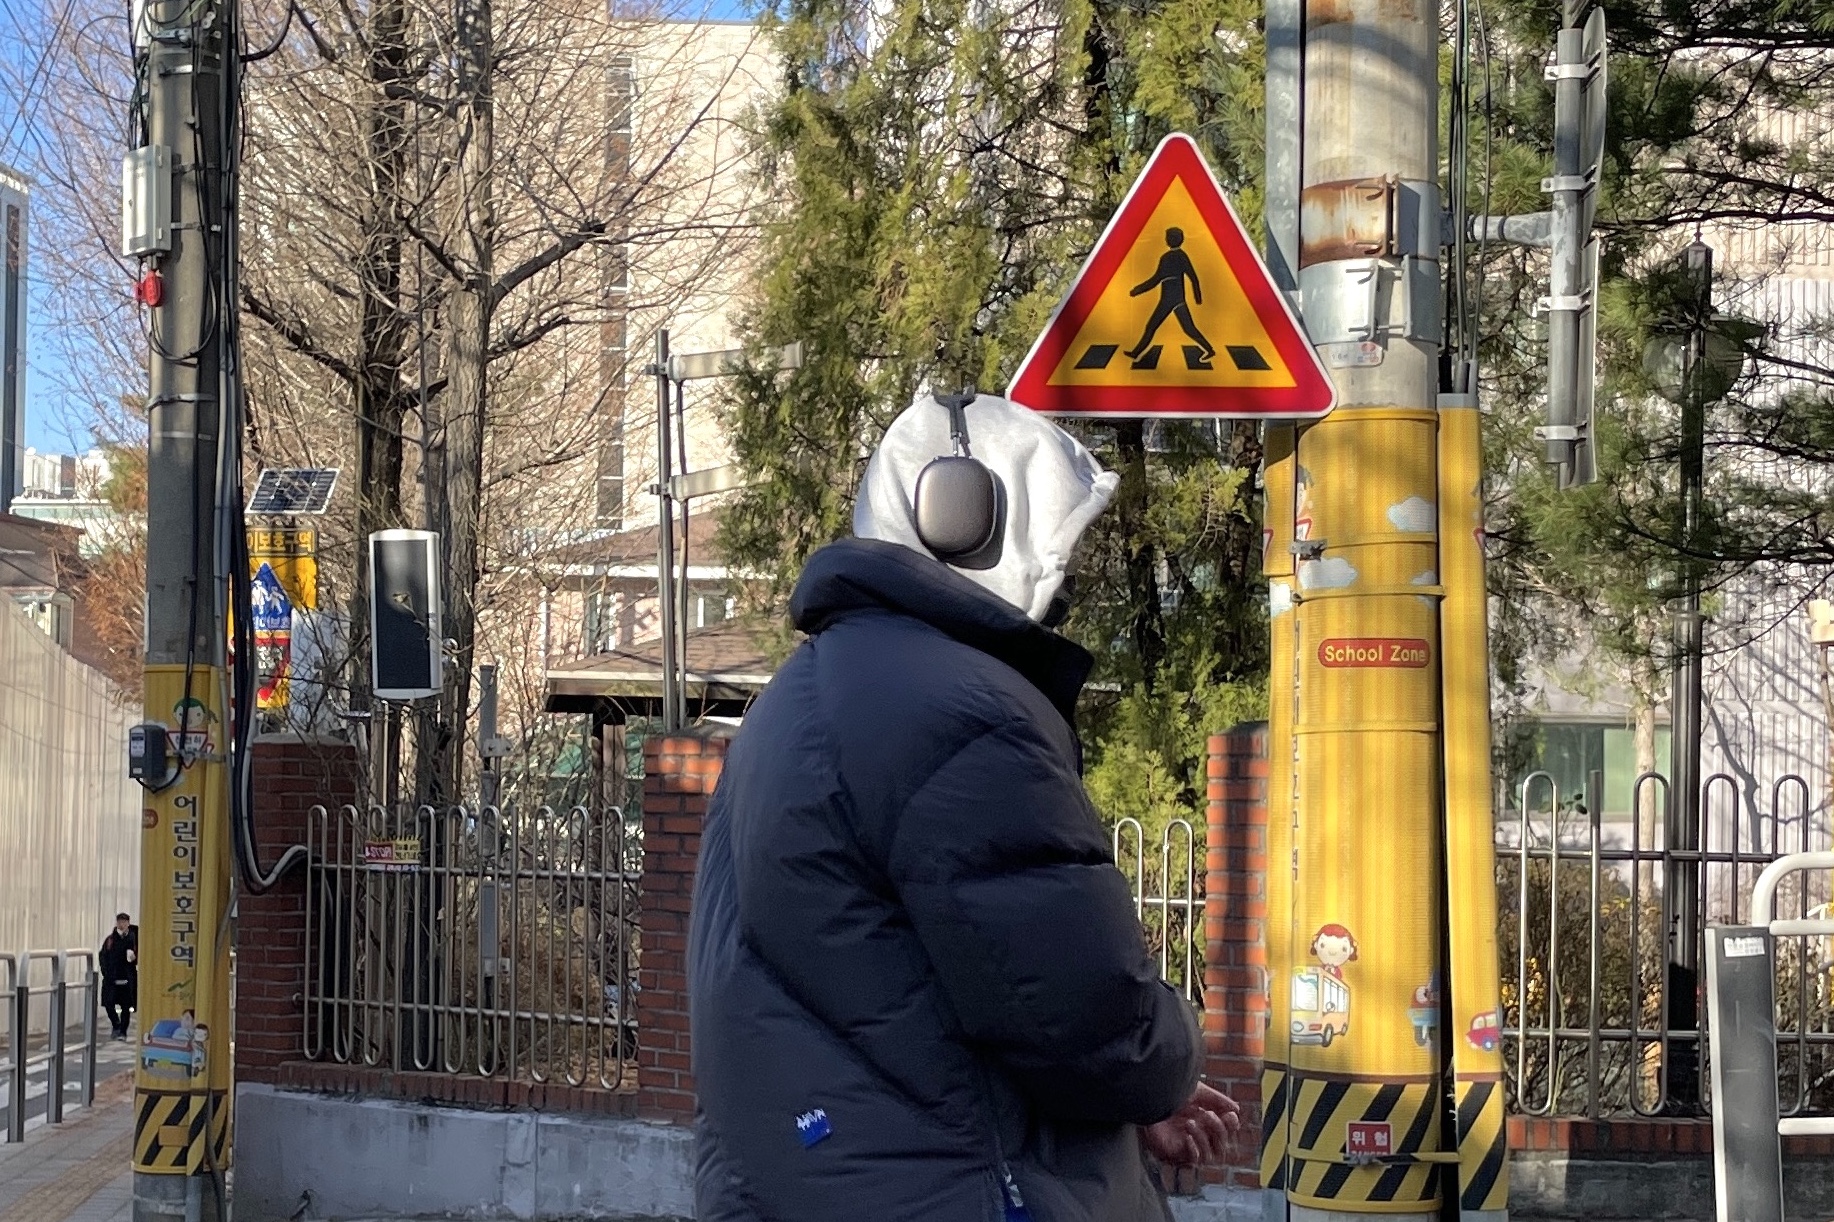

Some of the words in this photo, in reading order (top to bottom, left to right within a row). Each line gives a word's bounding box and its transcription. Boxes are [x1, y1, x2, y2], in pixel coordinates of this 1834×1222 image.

[1325, 644, 1383, 662] School
[1390, 645, 1426, 662] Zone
[171, 795, 198, 968] 어린이보호구역
